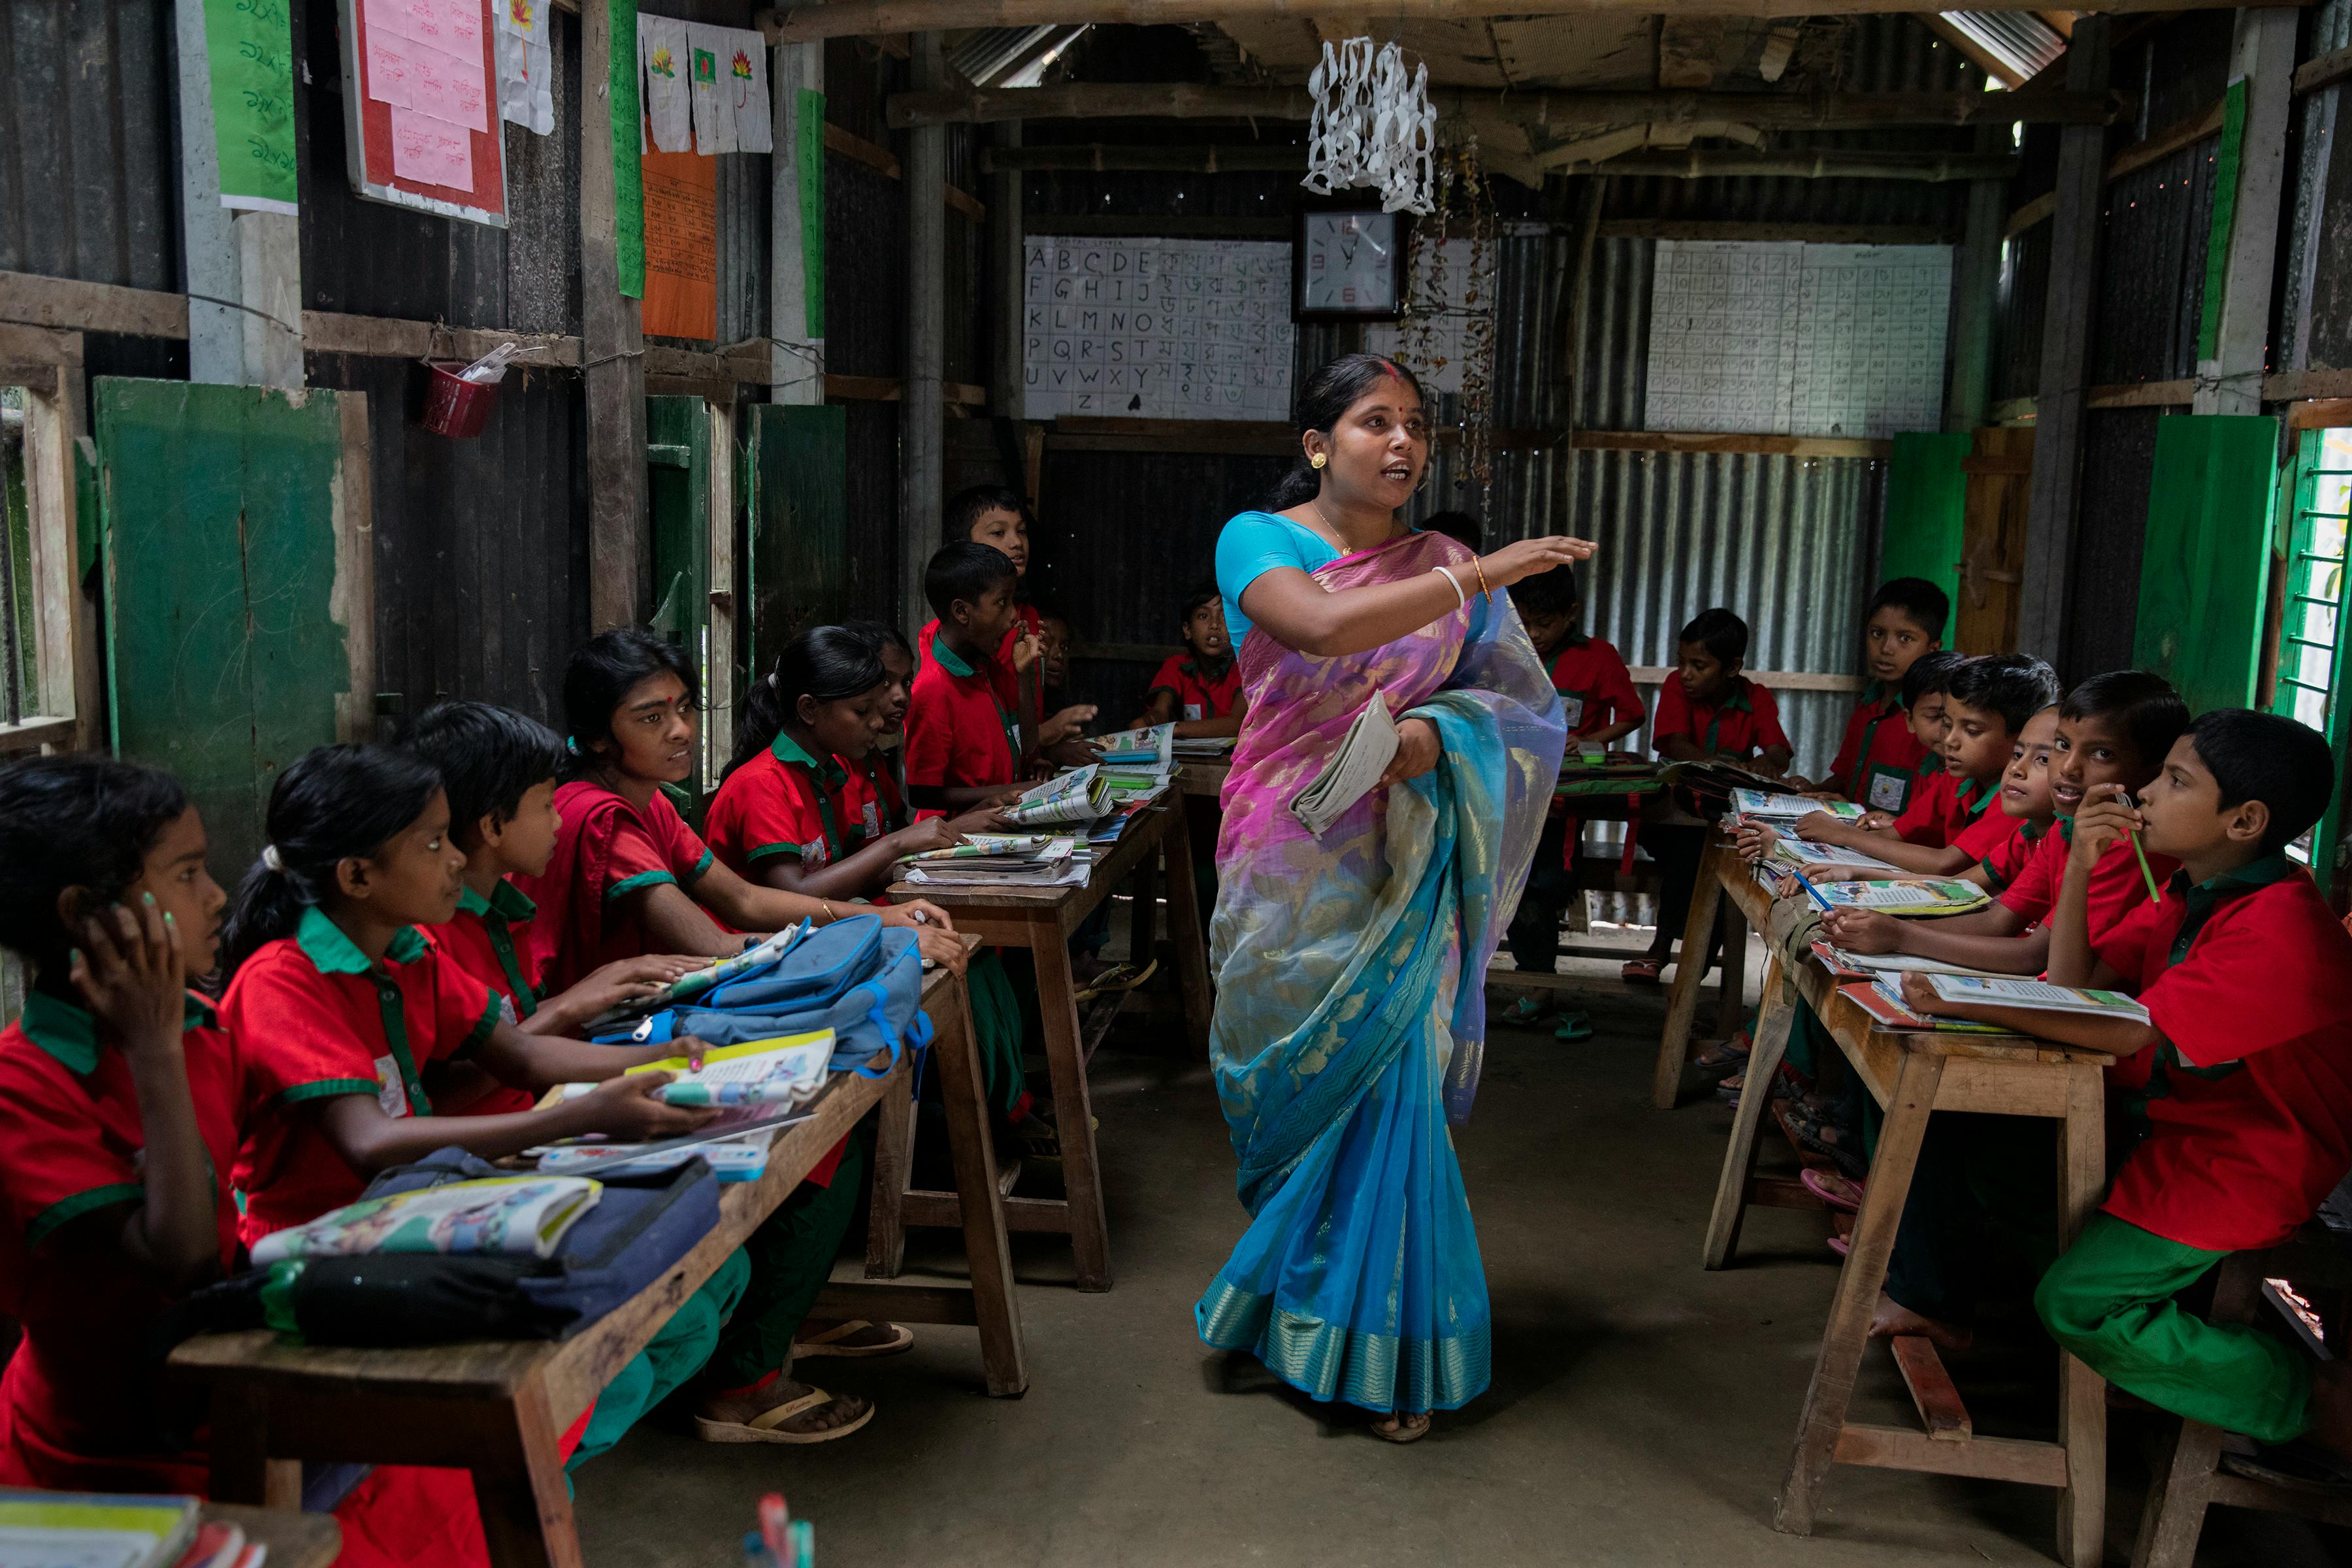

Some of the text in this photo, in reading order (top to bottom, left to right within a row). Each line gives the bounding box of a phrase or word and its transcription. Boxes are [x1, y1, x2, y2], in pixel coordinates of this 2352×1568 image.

[1029, 249, 1150, 273] A B C D E
[1312, 254, 1325, 270] 9
[1030, 277, 1149, 301] F G H I J
[1030, 310, 1152, 331] K L M N O
[1028, 340, 1039, 357] P
[1054, 340, 1070, 360] Q
[1112, 342, 1122, 361] S
[1135, 340, 1149, 357] T
[1026, 368, 1149, 388] U V W X Y
[1079, 395, 1091, 409] Z
